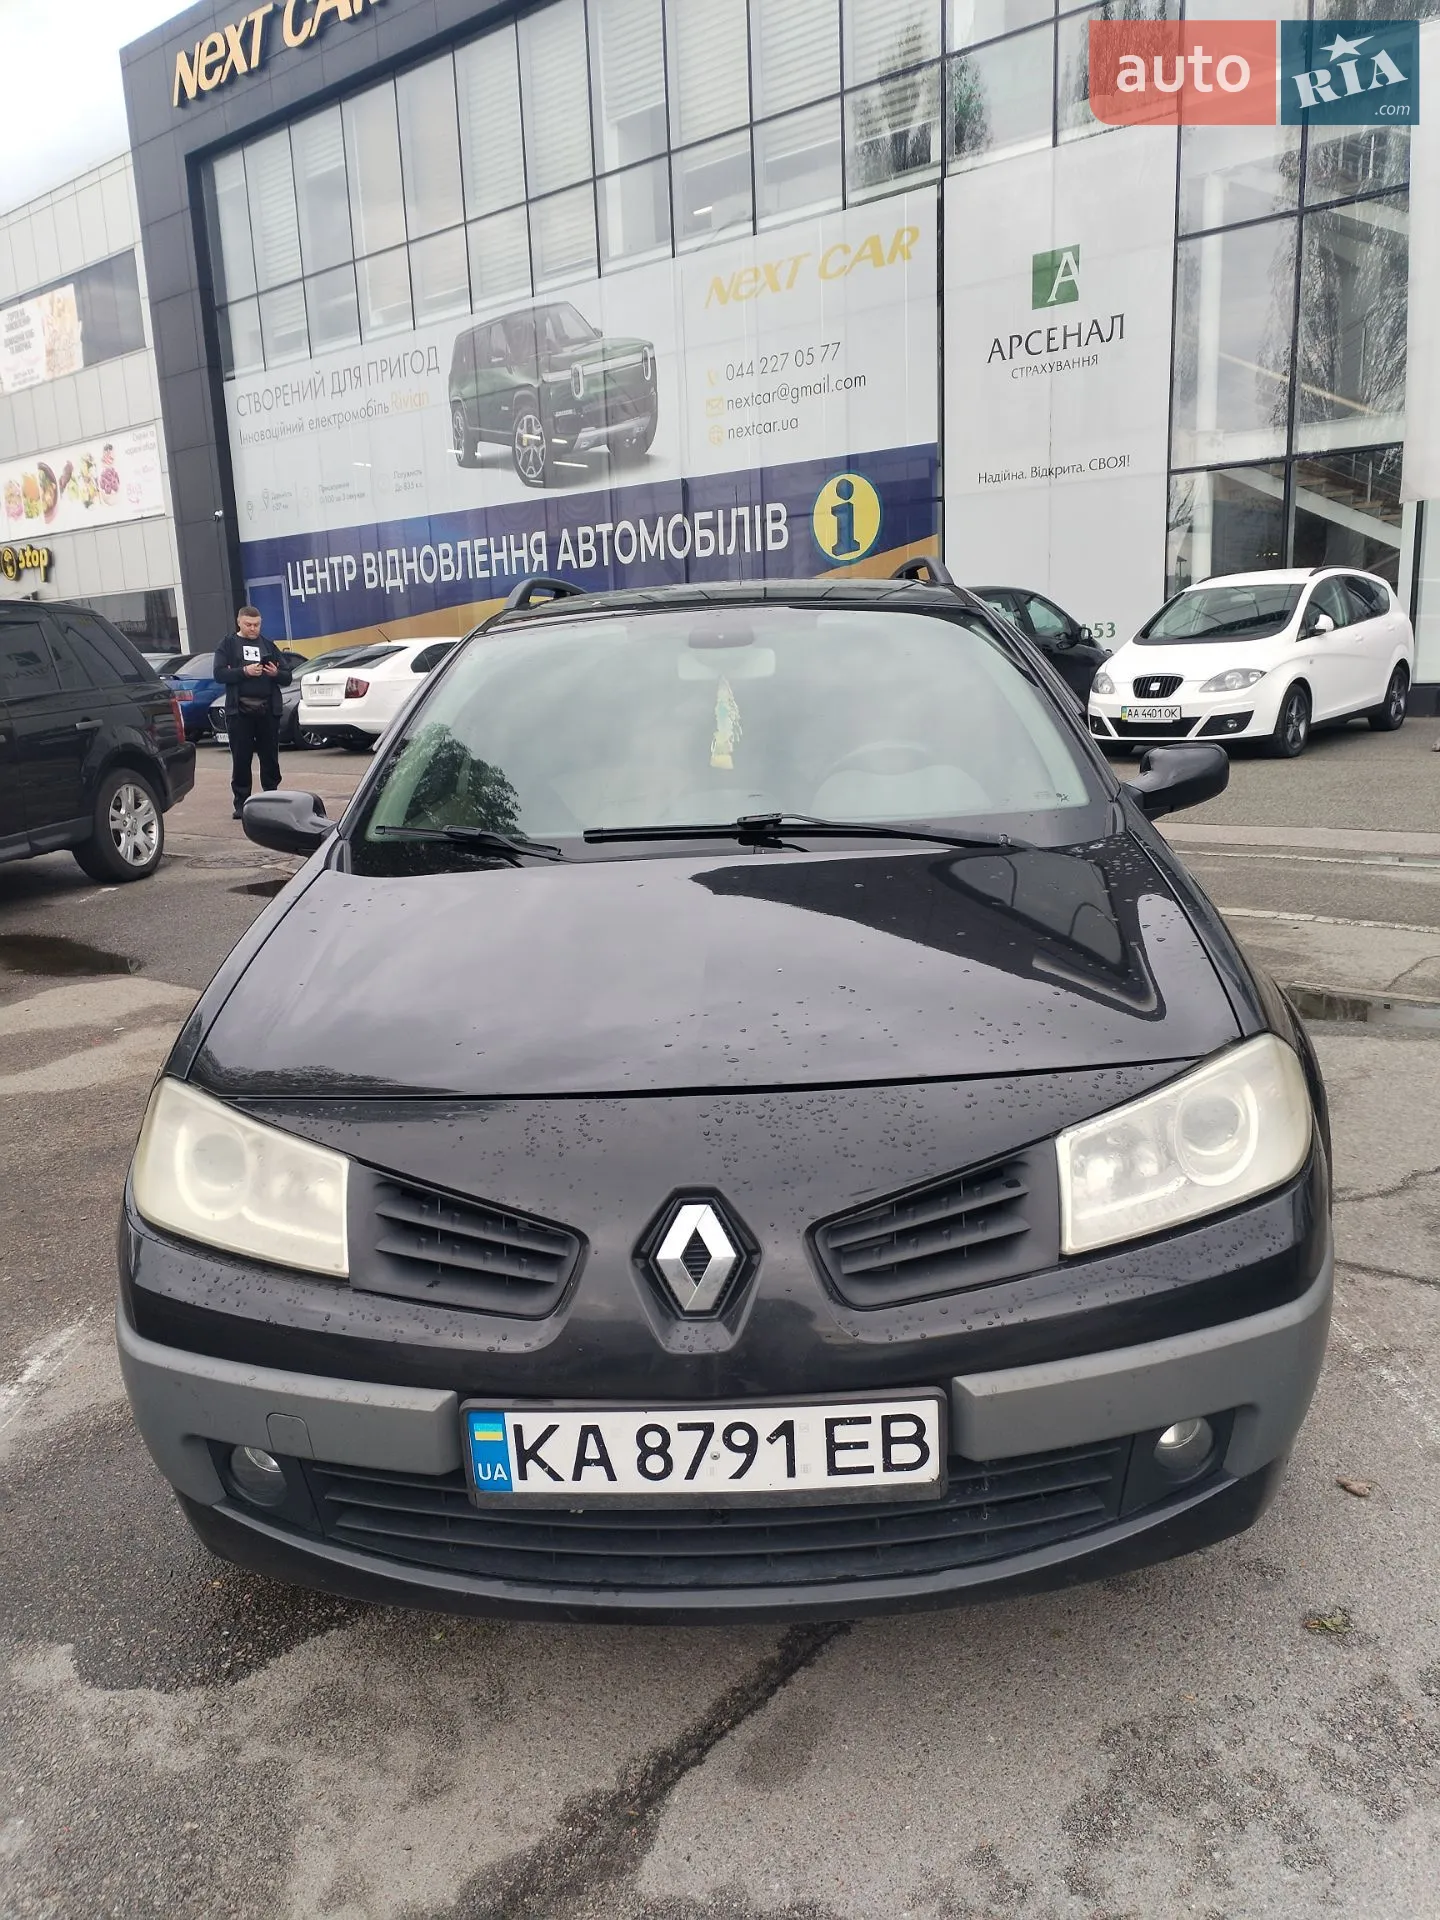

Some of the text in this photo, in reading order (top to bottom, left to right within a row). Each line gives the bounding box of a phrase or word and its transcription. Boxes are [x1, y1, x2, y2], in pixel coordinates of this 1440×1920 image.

[818, 225, 920, 281] CAR
[987, 313, 1125, 363] АРСЕНАЛ
[725, 342, 841, 381] 044 227 05 77
[1011, 354, 1099, 379] СТРАХУВАННЯ
[236, 346, 440, 417] СТВОРЕНИЙ ДЛЯ ПРИГОД
[726, 373, 867, 411] nextcar@gmail.com
[239, 389, 430, 445] Інноваційний електромобіль Rivian
[728, 415, 800, 440] nextcar.ua
[978, 454, 1131, 485] Надійна. Відкрита. СВОЯ!
[18, 544, 49, 582] stop
[287, 502, 789, 602] ЦЕНТР ВІДНОВЛЕННЯ АВТОМОБІЛІВ
[1142, 708, 1162, 718] 4401
[1164, 708, 1178, 718] OK
[513, 1413, 931, 1482] KA 8791 EB
[478, 1462, 508, 1482] UA
